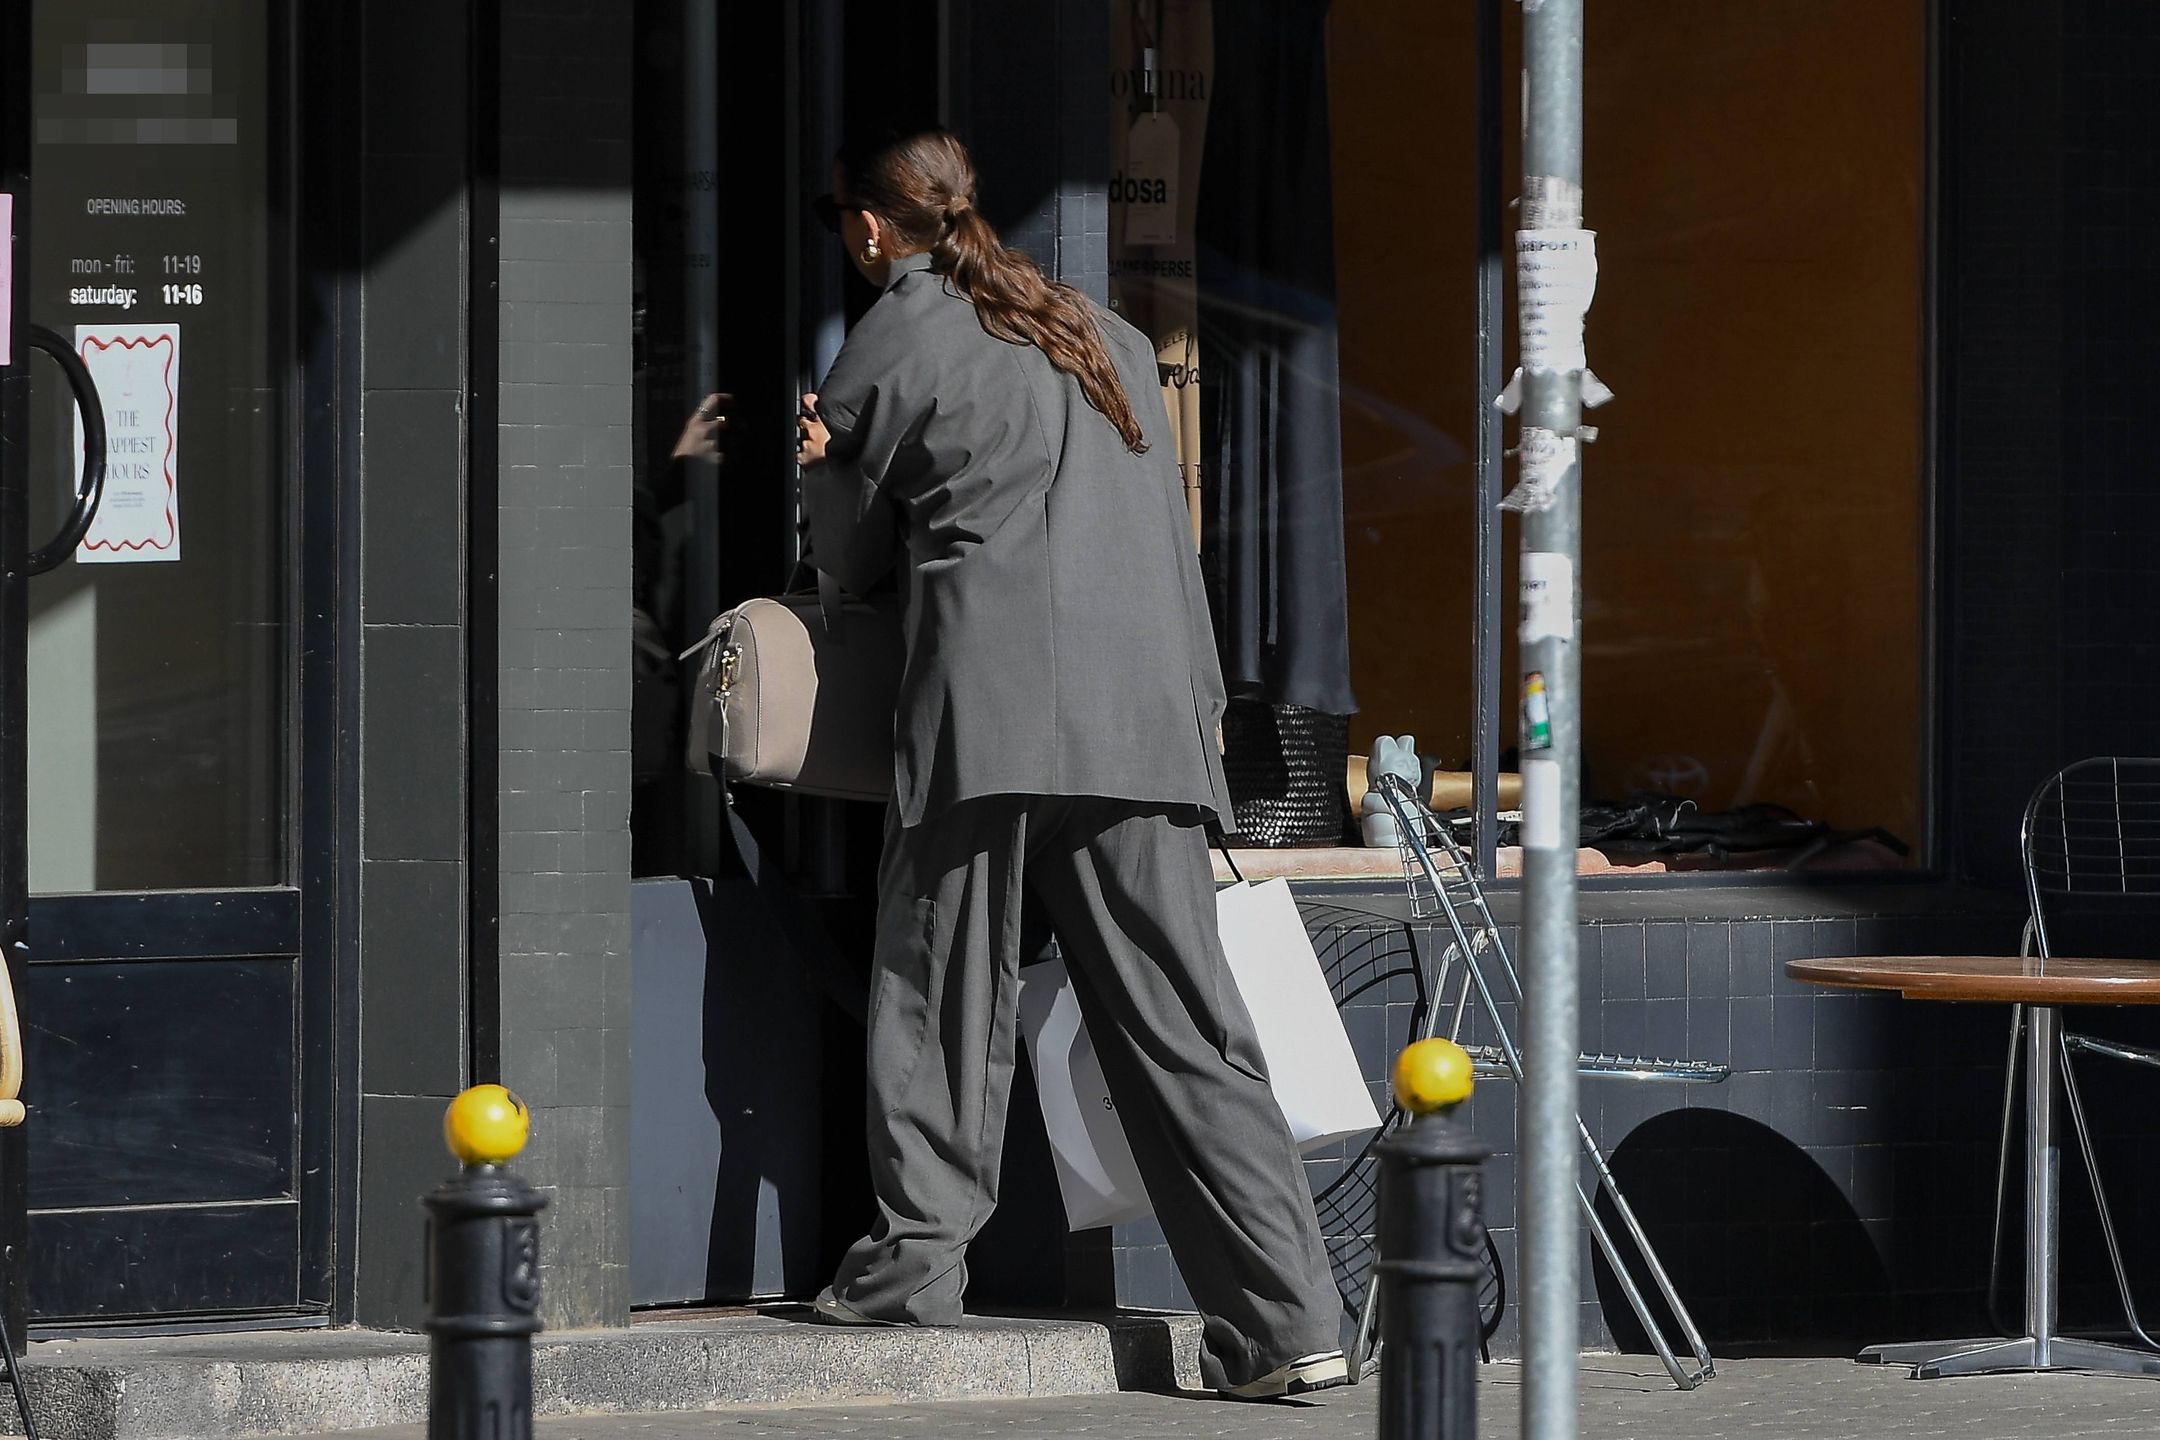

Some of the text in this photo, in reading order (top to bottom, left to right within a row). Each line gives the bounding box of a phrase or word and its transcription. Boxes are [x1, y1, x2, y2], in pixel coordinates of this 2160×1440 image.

[1108, 171, 1166, 203] dosa
[87, 198, 186, 215] OPENING HOURS:
[71, 258, 101, 273] mon
[115, 254, 135, 273] fri:
[163, 255, 201, 274] 11-19
[1152, 258, 1193, 278] PERSE
[70, 284, 203, 309] saturday: 11-16
[116, 410, 140, 427] THE
[107, 437, 157, 453] APPIEST
[106, 463, 150, 480] HOURS
